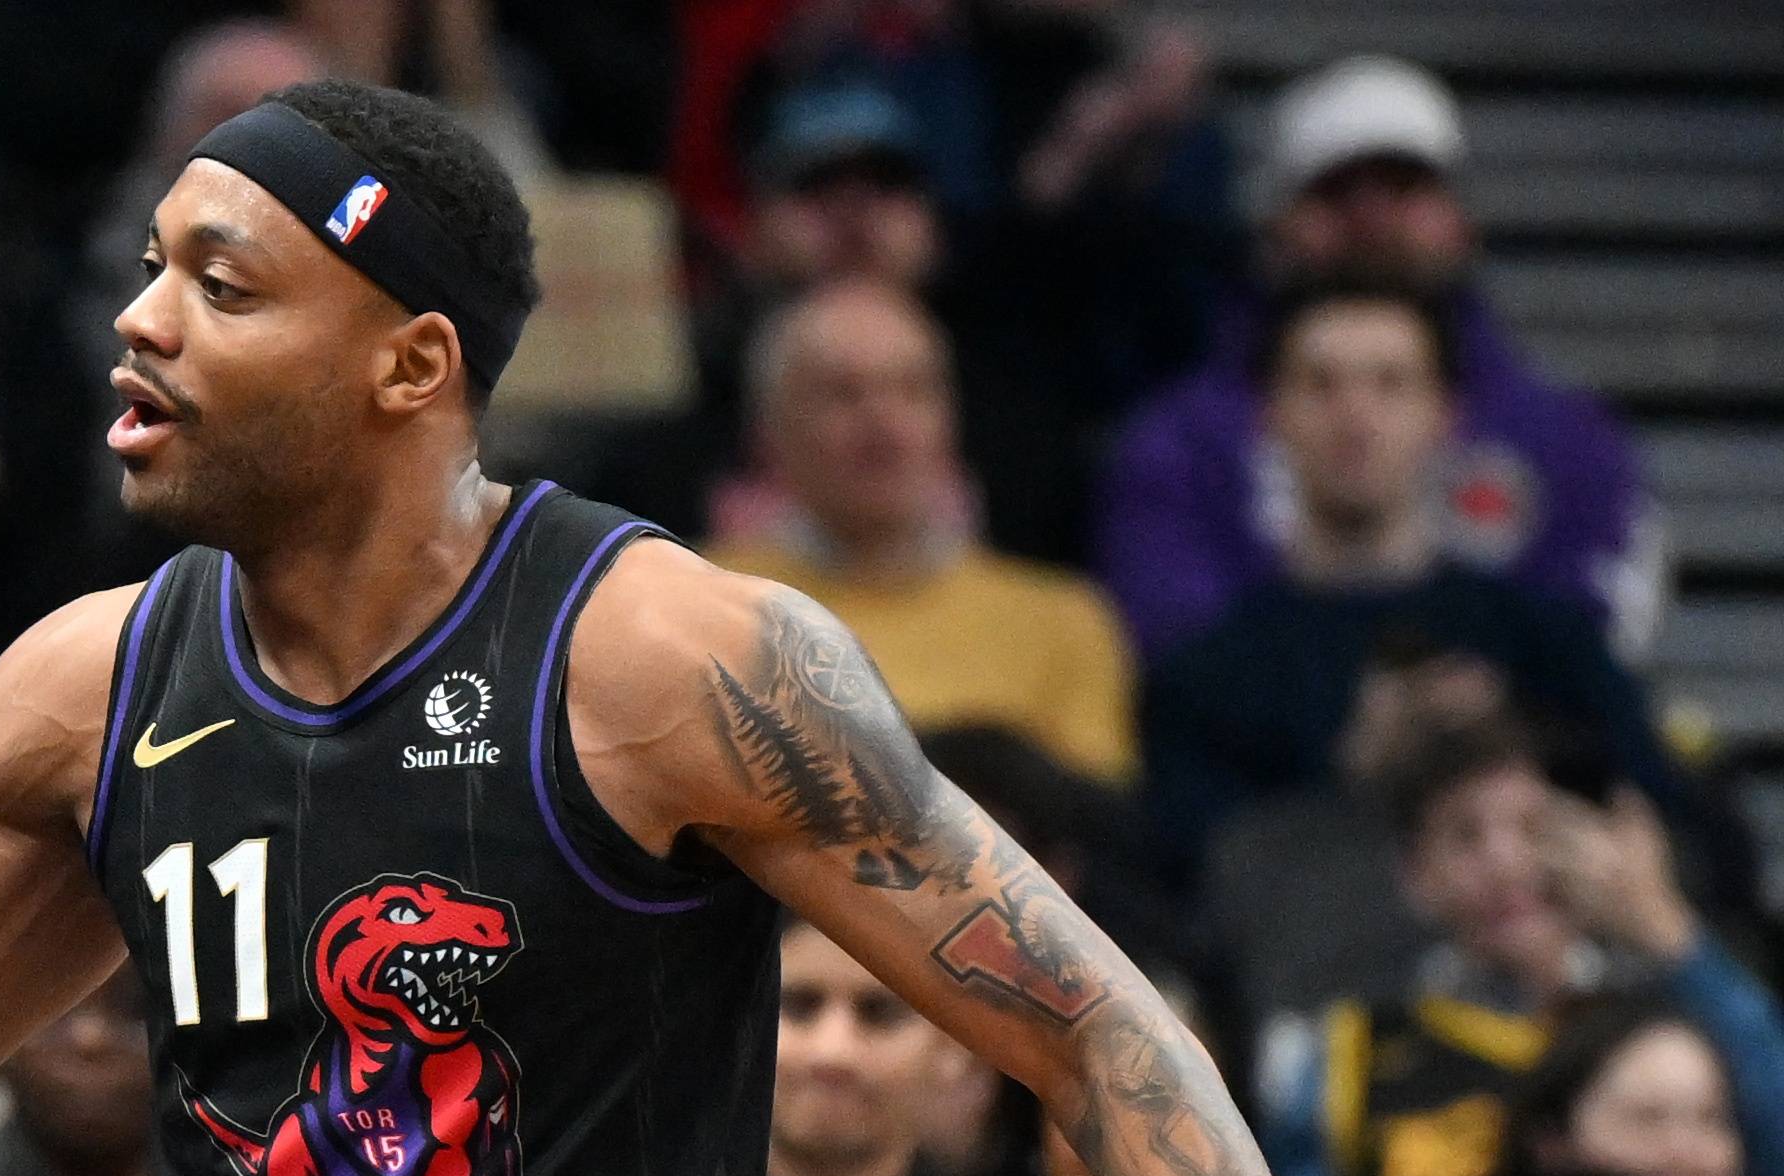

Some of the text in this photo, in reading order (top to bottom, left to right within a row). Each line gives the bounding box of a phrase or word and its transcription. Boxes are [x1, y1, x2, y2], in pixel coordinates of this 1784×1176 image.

[402, 739, 501, 769] Sun Life
[142, 837, 270, 1026] 11
[337, 1108, 396, 1132] TOR
[362, 1134, 408, 1172] 15
